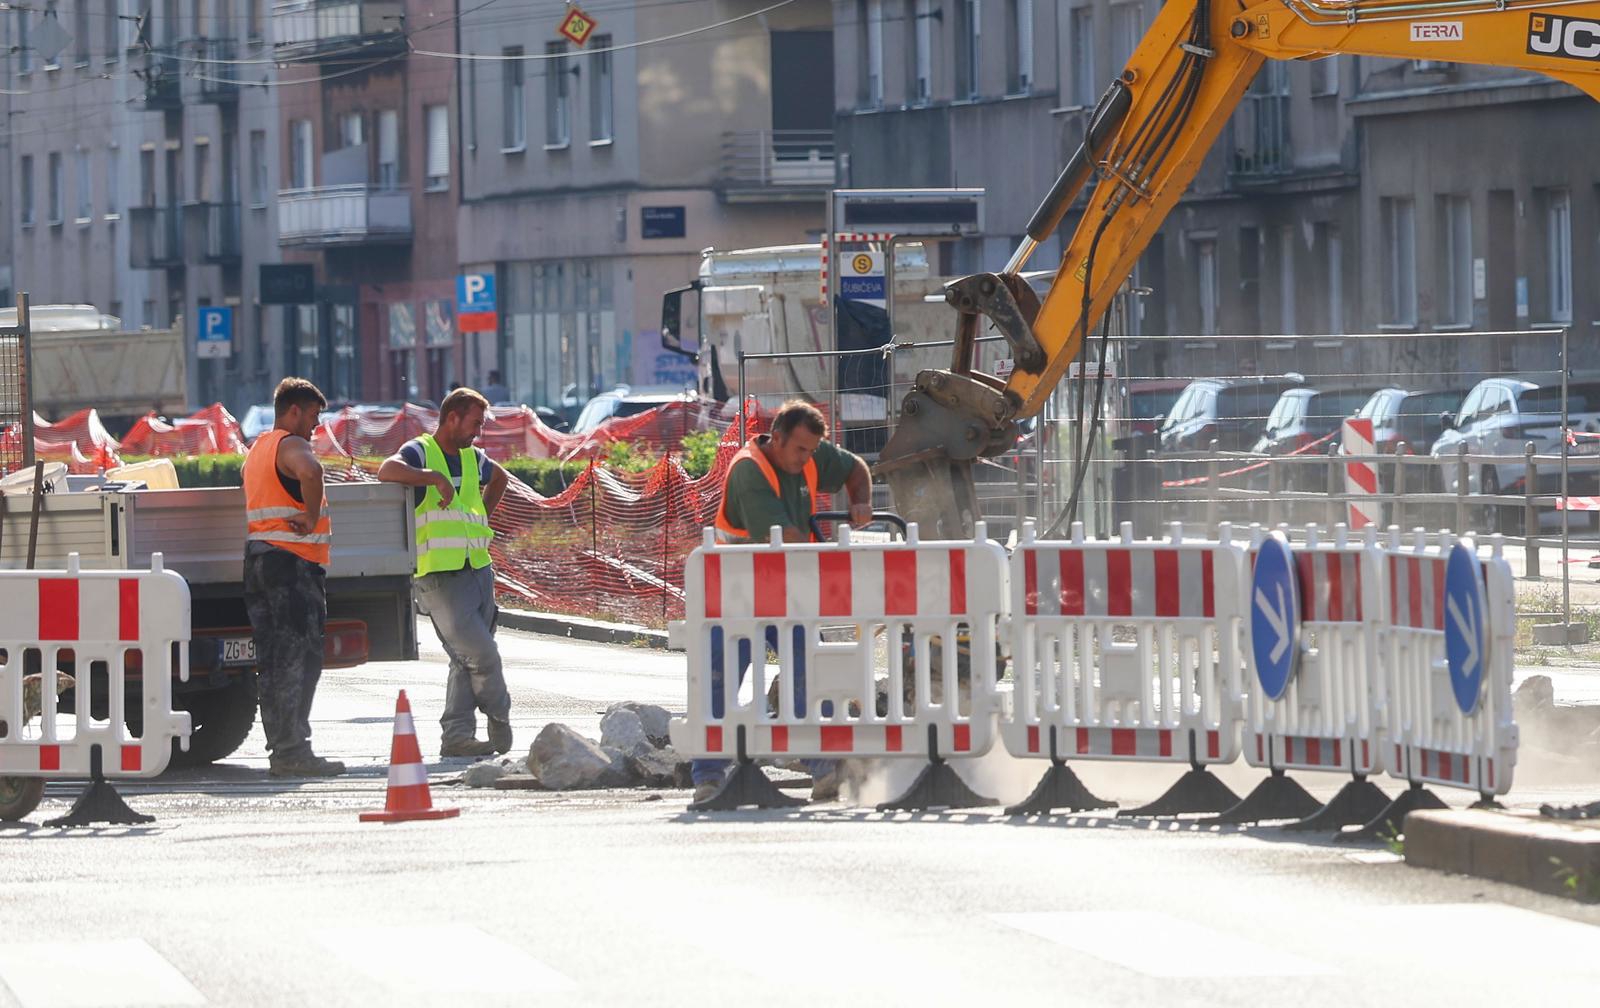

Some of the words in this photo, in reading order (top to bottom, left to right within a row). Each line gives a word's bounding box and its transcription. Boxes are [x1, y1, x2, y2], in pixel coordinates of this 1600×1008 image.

[571, 19, 585, 33] 20
[1413, 25, 1459, 38] TERRA
[465, 275, 486, 304] P
[207, 312, 222, 334] P
